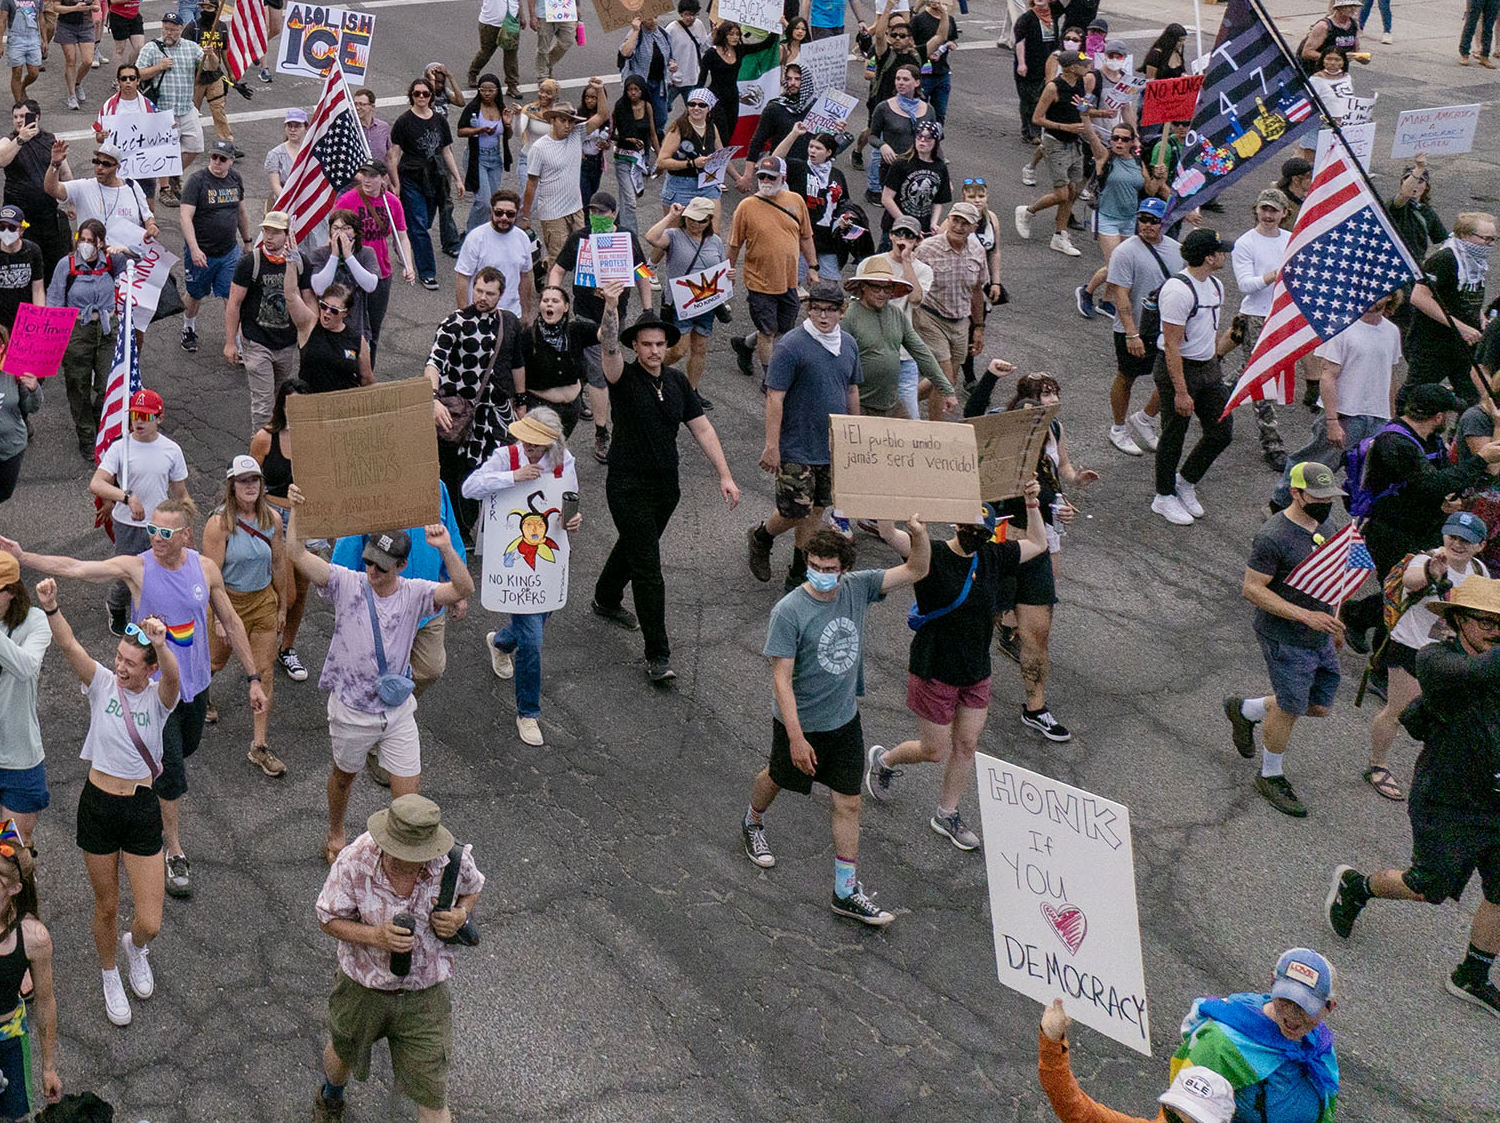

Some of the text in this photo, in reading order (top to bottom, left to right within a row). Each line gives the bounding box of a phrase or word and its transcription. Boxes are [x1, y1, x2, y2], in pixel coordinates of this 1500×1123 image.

[287, 5, 372, 37] ABOLISH
[282, 22, 371, 78] ICE
[1148, 82, 1169, 98] NO
[1401, 110, 1476, 127] MAKE AMERICA
[21, 306, 71, 319] Melissa
[694, 300, 705, 309] NO
[18, 315, 72, 338] Hortman
[869, 429, 942, 453] pueblo unido
[332, 456, 401, 490] LANDS
[843, 451, 980, 475] jamás será vencido!
[489, 574, 542, 589] NO KINGS
[501, 590, 546, 607] JOKERS
[105, 698, 151, 727] BOTON
[990, 768, 1122, 851] HONK
[1028, 830, 1054, 857] If
[1000, 852, 1068, 903] YOU
[1289, 962, 1314, 982] LOVE
[1002, 932, 1147, 1039] DEMOCRACY
[1184, 1079, 1208, 1095] BLE
